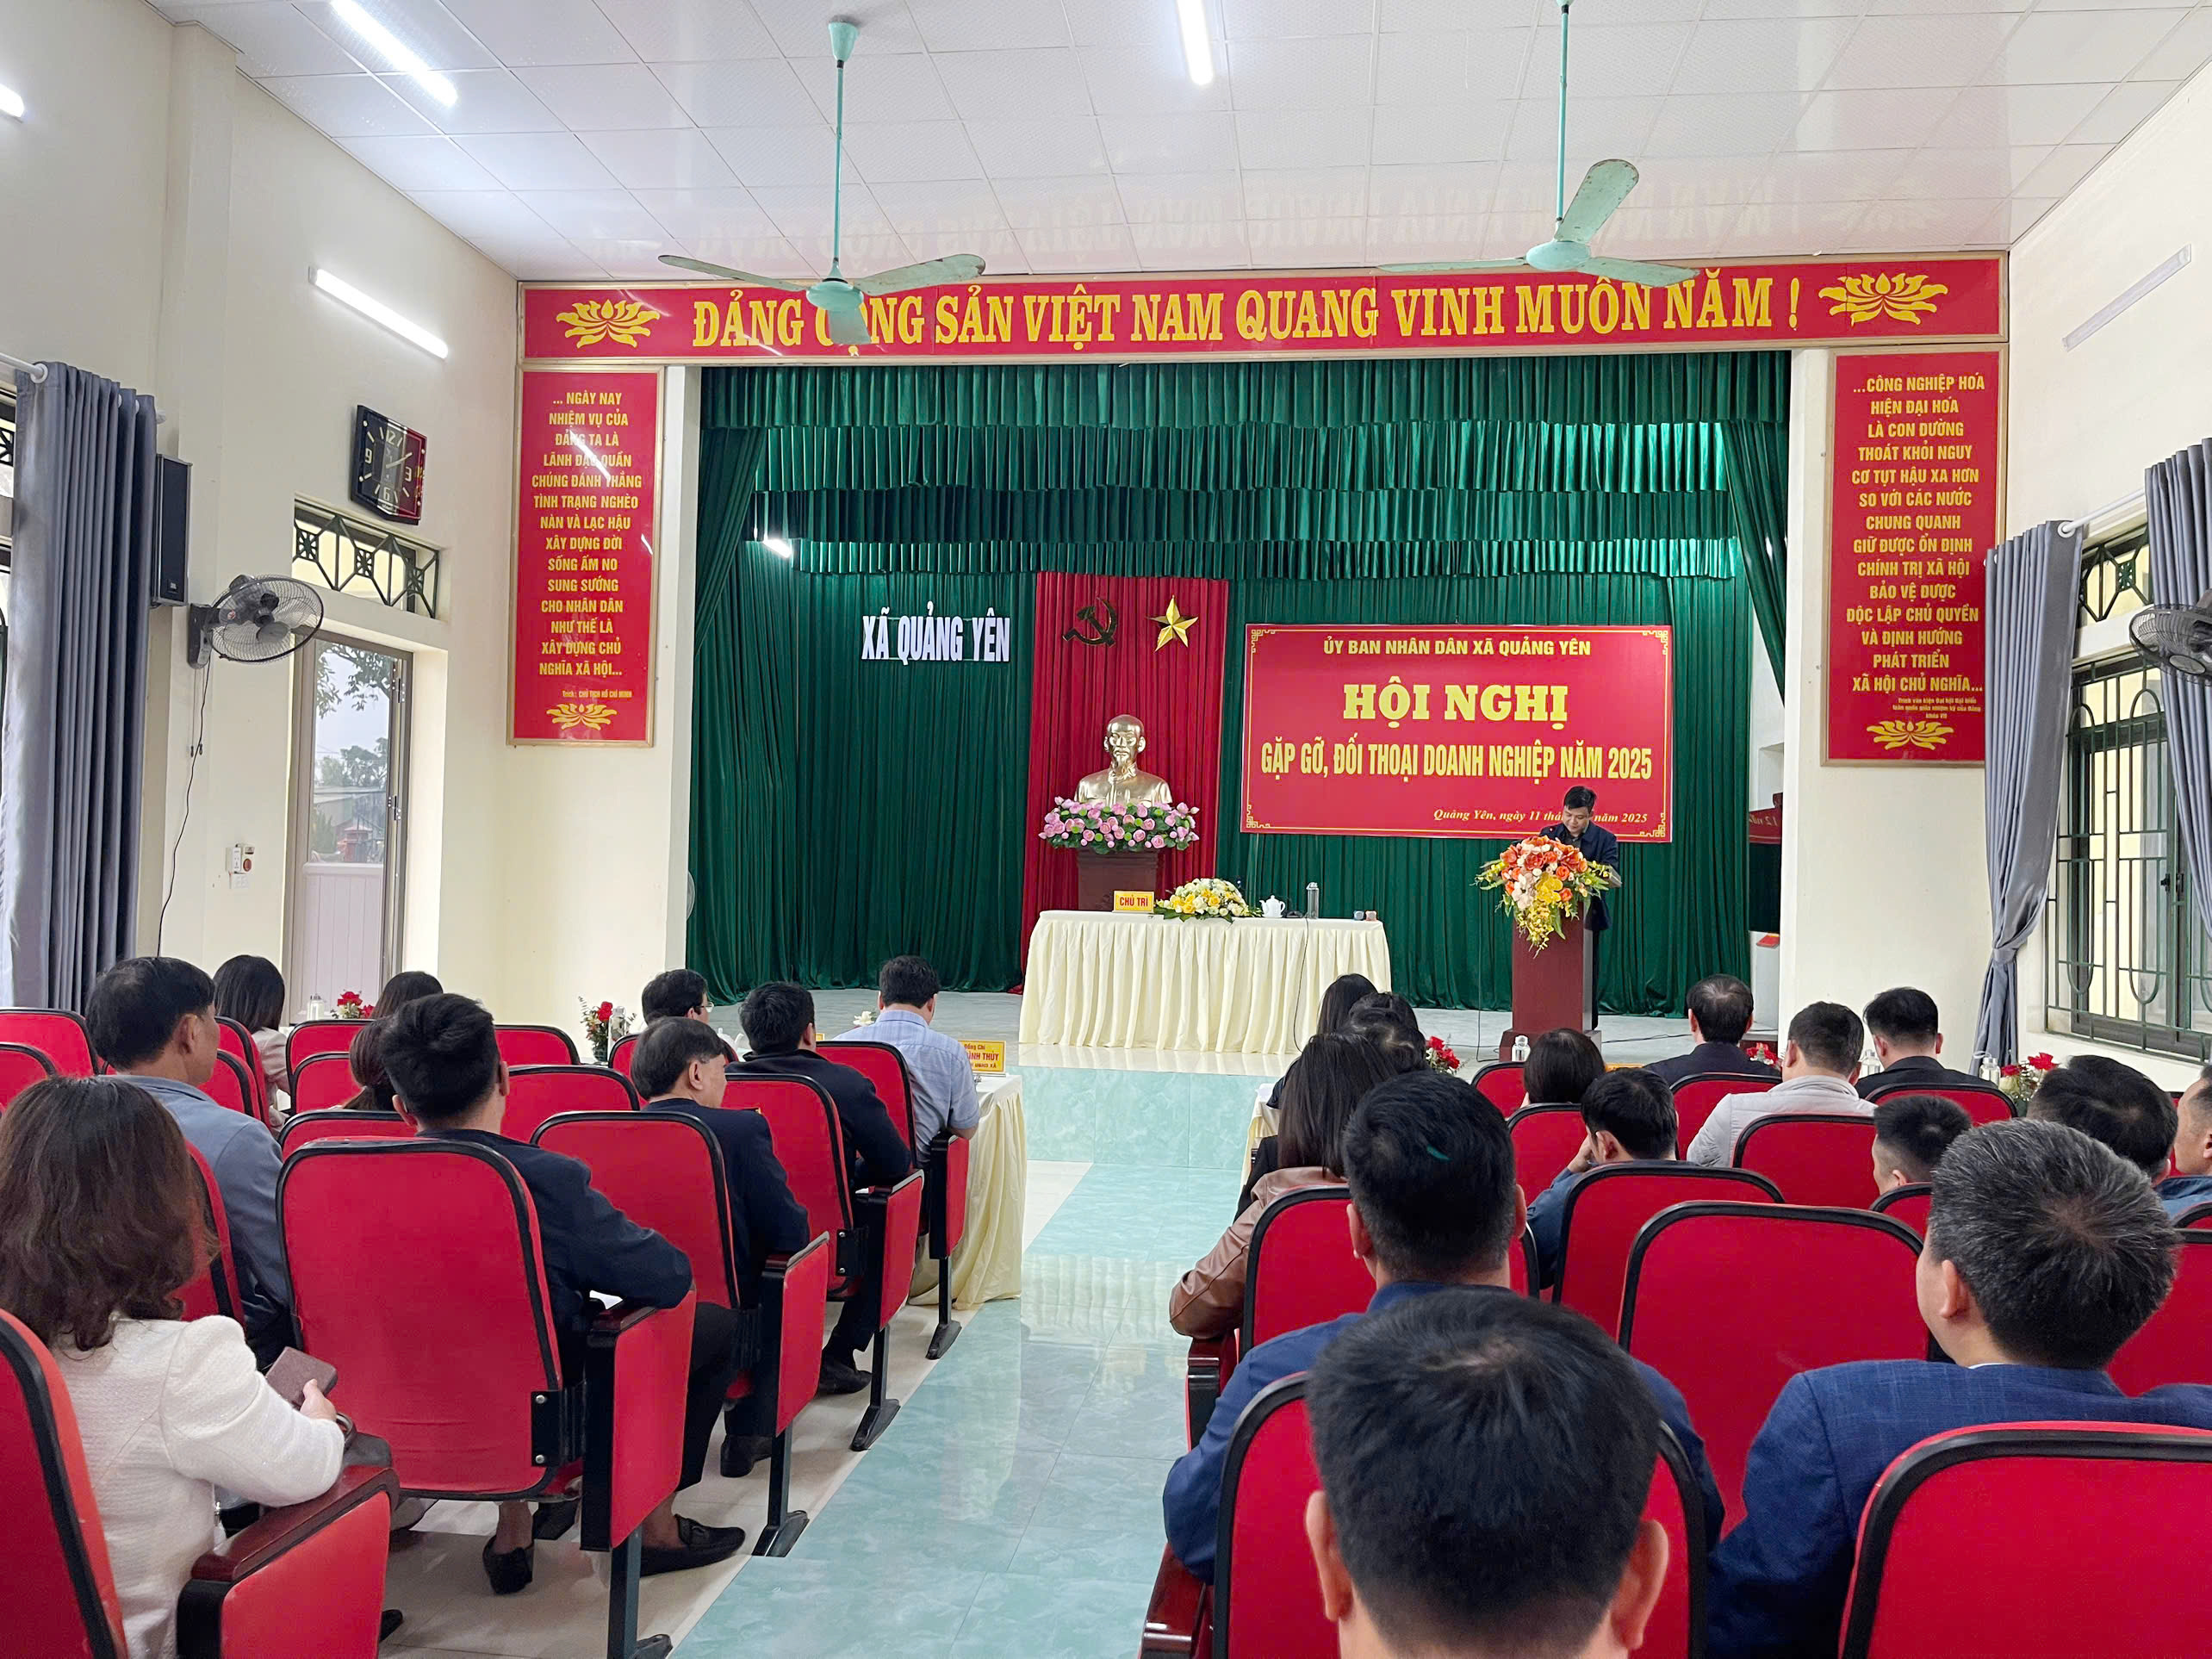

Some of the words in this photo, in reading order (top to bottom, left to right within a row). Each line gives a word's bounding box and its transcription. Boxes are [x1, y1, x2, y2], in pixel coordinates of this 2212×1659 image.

[693, 289, 805, 348] ĐẢNG
[935, 284, 1014, 345] SẢN
[1025, 283, 1120, 351] VIỆT
[1130, 293, 1224, 341] NAM
[1235, 288, 1378, 342] QUANG
[1391, 285, 1504, 337] VINH
[1515, 275, 1653, 334] MUÔN
[1663, 268, 1773, 329] NĂM
[1788, 277, 1800, 331] !
[1906, 374, 1955, 393] NGHIỆP
[566, 389, 596, 405] NGÀY
[599, 392, 622, 405] NAY
[1870, 398, 1902, 418] HIỆN
[1906, 400, 1929, 417] ĐẠI
[549, 410, 586, 428] NHIỆM
[588, 413, 603, 428] VỤ
[606, 408, 629, 426] CỦA
[1868, 420, 1884, 438] LÀ
[1888, 423, 1916, 438] CON
[588, 433, 602, 446] TA
[606, 432, 619, 446] LÀ
[364, 448, 373, 464] 9
[544, 452, 572, 467] LÃNH
[1858, 444, 1898, 462] THOÁT
[1903, 440, 1934, 461] KHỎI
[1938, 445, 1973, 461] NGUY
[405, 466, 413, 482] 3
[531, 472, 569, 488] CHÚNG
[571, 472, 601, 488] ĐÁNH
[1852, 469, 1872, 484] CƠ
[1873, 469, 1897, 487] TỤT
[1900, 466, 1927, 487] HẬU
[1930, 469, 1948, 483] XA
[1952, 468, 1979, 483] HƠN
[382, 487, 390, 501] 6
[533, 493, 558, 508] TÌNH
[561, 495, 597, 511] TRẠNG
[601, 494, 639, 509] NGHÈO
[1859, 494, 1877, 507] SO
[1881, 488, 1902, 506] VỚI
[1905, 488, 1933, 506] CÁC
[1936, 487, 1973, 506] NƯỚC
[540, 514, 563, 529] NÀN
[567, 514, 581, 529] VÀ
[584, 517, 605, 531] LẠC
[608, 514, 631, 531] HẬU
[1866, 516, 1911, 530] CHUNG
[1916, 515, 1960, 531] QUANH
[545, 534, 566, 550] XÂY
[569, 537, 600, 552] DỰNG
[603, 534, 623, 550] ĐỜI
[1853, 536, 1877, 553] GIỮ
[1880, 537, 1915, 556] ĐƯỢC
[1918, 532, 1937, 553] ỔN
[1941, 537, 1973, 556] ĐỊNH
[548, 556, 578, 571] SỐNG
[581, 556, 599, 571] ẤM
[602, 558, 618, 571] NO
[1857, 559, 1898, 576] CHÍNH
[1902, 562, 1923, 579] TRỊ
[1927, 558, 1944, 575] XÃ
[1948, 558, 1970, 579] HỘI
[548, 579, 578, 592] SUNG
[581, 575, 619, 593] SƯỚNG
[1869, 580, 1897, 600] BẢO
[1900, 582, 1917, 602] VỆ
[541, 600, 563, 613] CHO
[566, 598, 597, 613] NHÂN
[600, 598, 624, 613] DÂN
[1877, 606, 1902, 624] LẬP
[1905, 602, 1933, 622] CHỦ
[1936, 603, 1979, 623] QUYỀN
[551, 620, 575, 634] NHƯ
[577, 617, 597, 634] THẾ
[600, 618, 613, 634] LÀ
[861, 606, 890, 660] XÃ
[898, 600, 964, 666] QUẢNG
[972, 607, 1010, 662] YÊN
[1861, 628, 1879, 645] VÀ
[1917, 627, 1963, 645] HƯỚNG
[541, 639, 562, 655] XÂY
[565, 642, 596, 657] DỰNG
[599, 637, 621, 655] CHỦ
[1323, 636, 1345, 655] ỦY
[1348, 640, 1380, 655] BAN
[1385, 637, 1432, 656] NHÂN
[1434, 637, 1468, 656] DÂN
[1472, 637, 1495, 656] XÃ
[1499, 635, 1556, 657] QUẢNG
[1559, 637, 1591, 656] YÊN
[1873, 651, 1908, 668] PHÁT
[1911, 649, 1949, 668] TRIỂN
[539, 661, 573, 675] NGHĨA
[575, 661, 591, 675] XÃ
[1852, 673, 1871, 692] XÃ
[1874, 674, 1896, 694] HỘI
[1900, 672, 1927, 692] CHỦ
[1343, 675, 1430, 729] HỘI
[1445, 684, 1569, 730] NGHỊ
[1261, 736, 1296, 780] GẶP
[1333, 732, 1364, 774] ĐỐI
[1368, 743, 1419, 783] THOẠI
[1423, 744, 1483, 777] DOANH
[1488, 739, 1555, 785] NGHIỆP
[1560, 741, 1603, 779] NĂM
[1607, 748, 1652, 780] 2025
[1433, 809, 1469, 821] Quảng
[1474, 809, 1497, 821] Yên,
[1500, 810, 1525, 822] ngày
[1529, 811, 1540, 821] 11
[1594, 814, 1619, 823] năm
[1623, 813, 1648, 823] 2025
[1119, 894, 1135, 907] CHỦ
[1136, 895, 1148, 907] TRÌ
